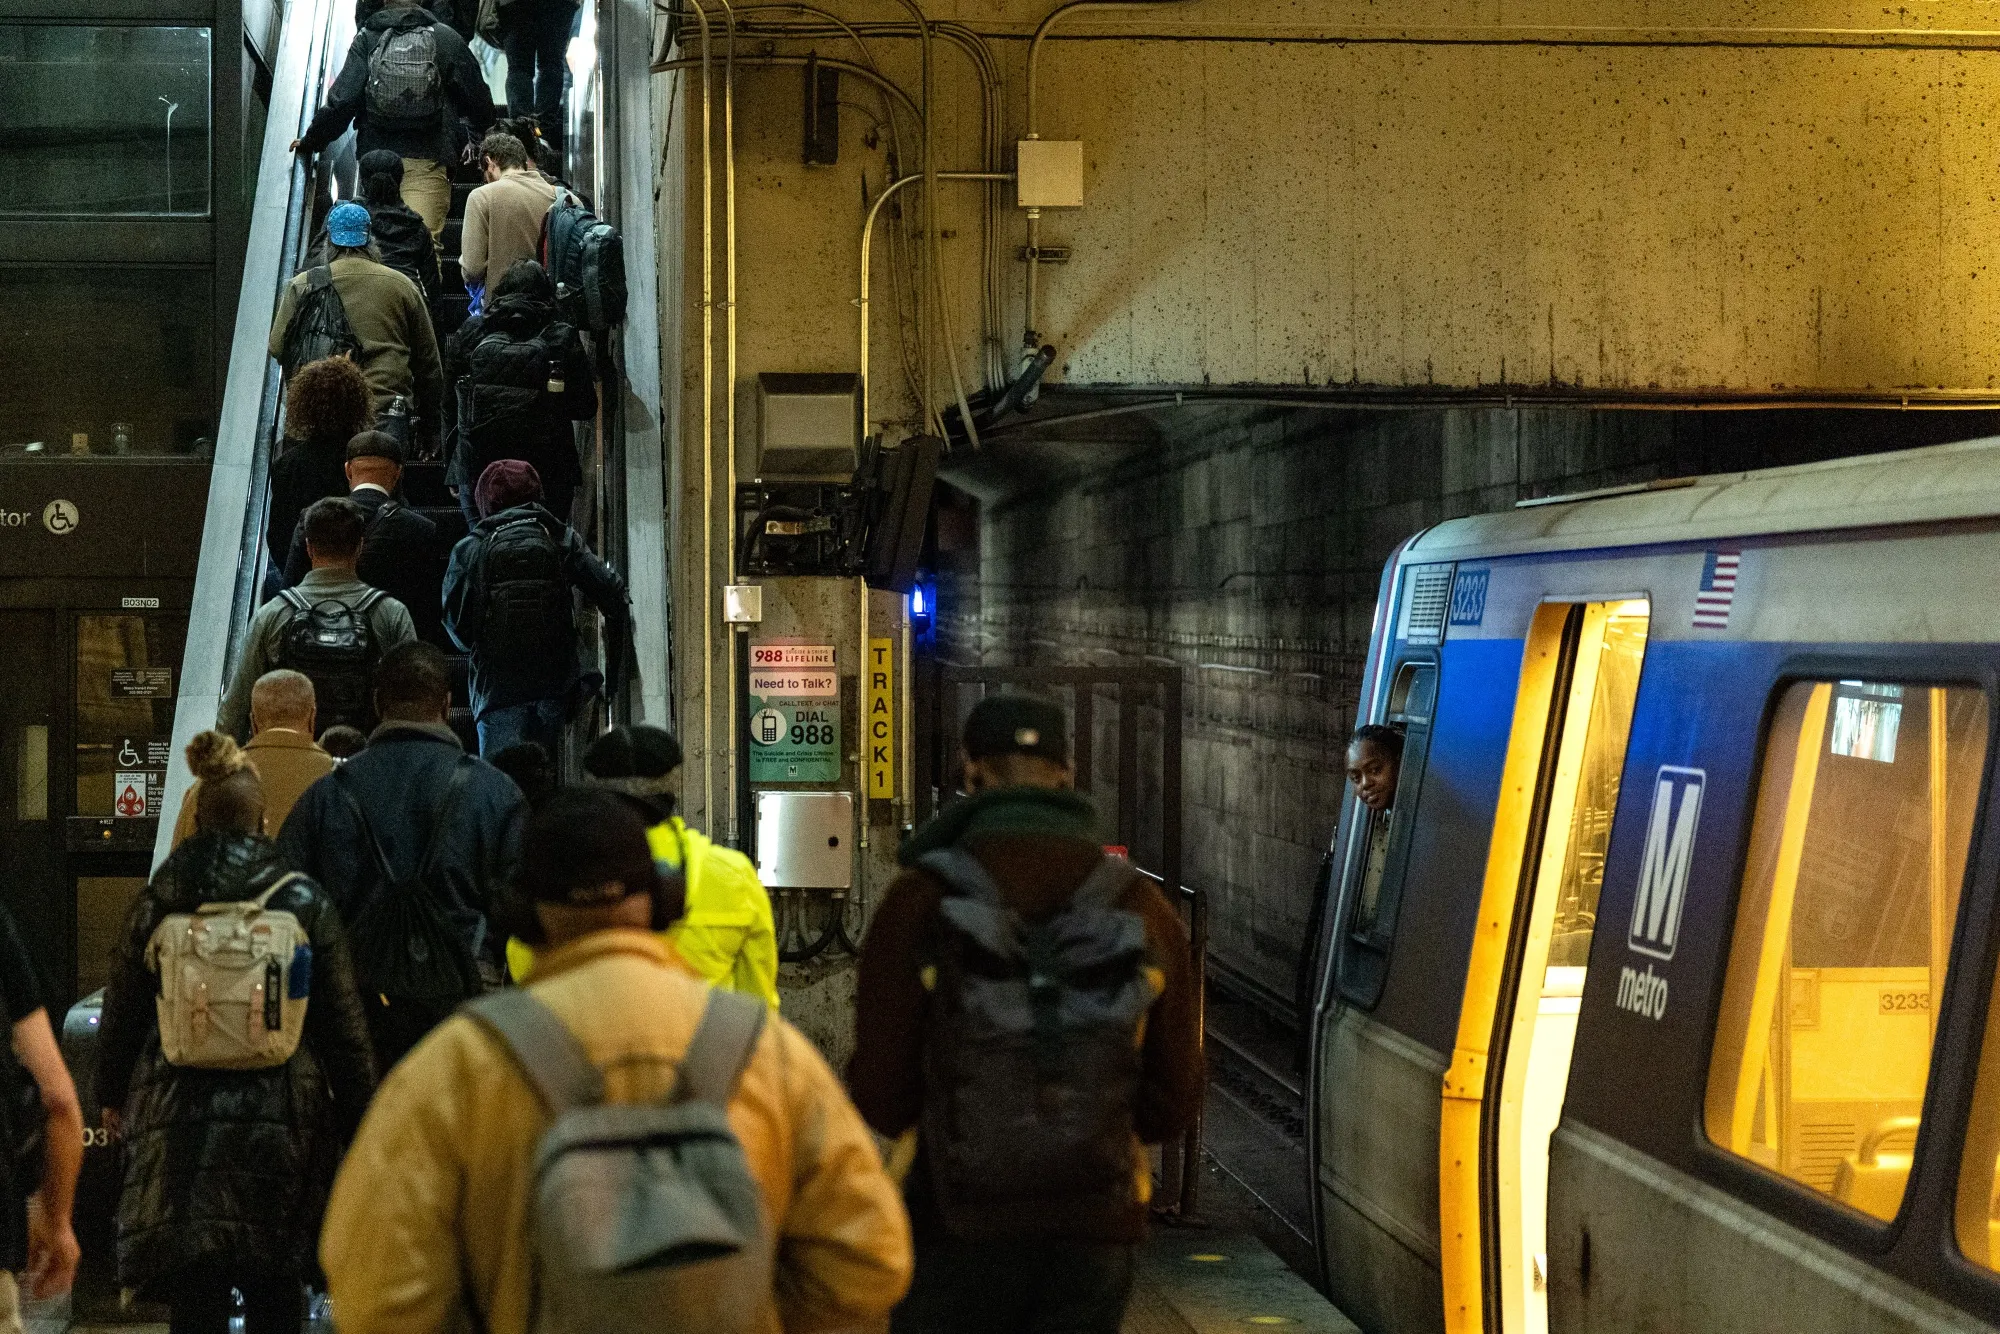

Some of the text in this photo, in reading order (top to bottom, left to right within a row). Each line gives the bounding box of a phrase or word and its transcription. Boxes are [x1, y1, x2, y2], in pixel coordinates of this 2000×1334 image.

[1452, 575, 1487, 621] 3233
[755, 650, 783, 662] 988
[754, 678, 832, 688] Need to Talk?
[873, 648, 888, 763] TRACK
[796, 711, 828, 722] DIAL
[790, 724, 834, 745] 988
[1632, 781, 1701, 947] M
[1616, 964, 1669, 1021] metro
[1882, 993, 1930, 1010] 3233
